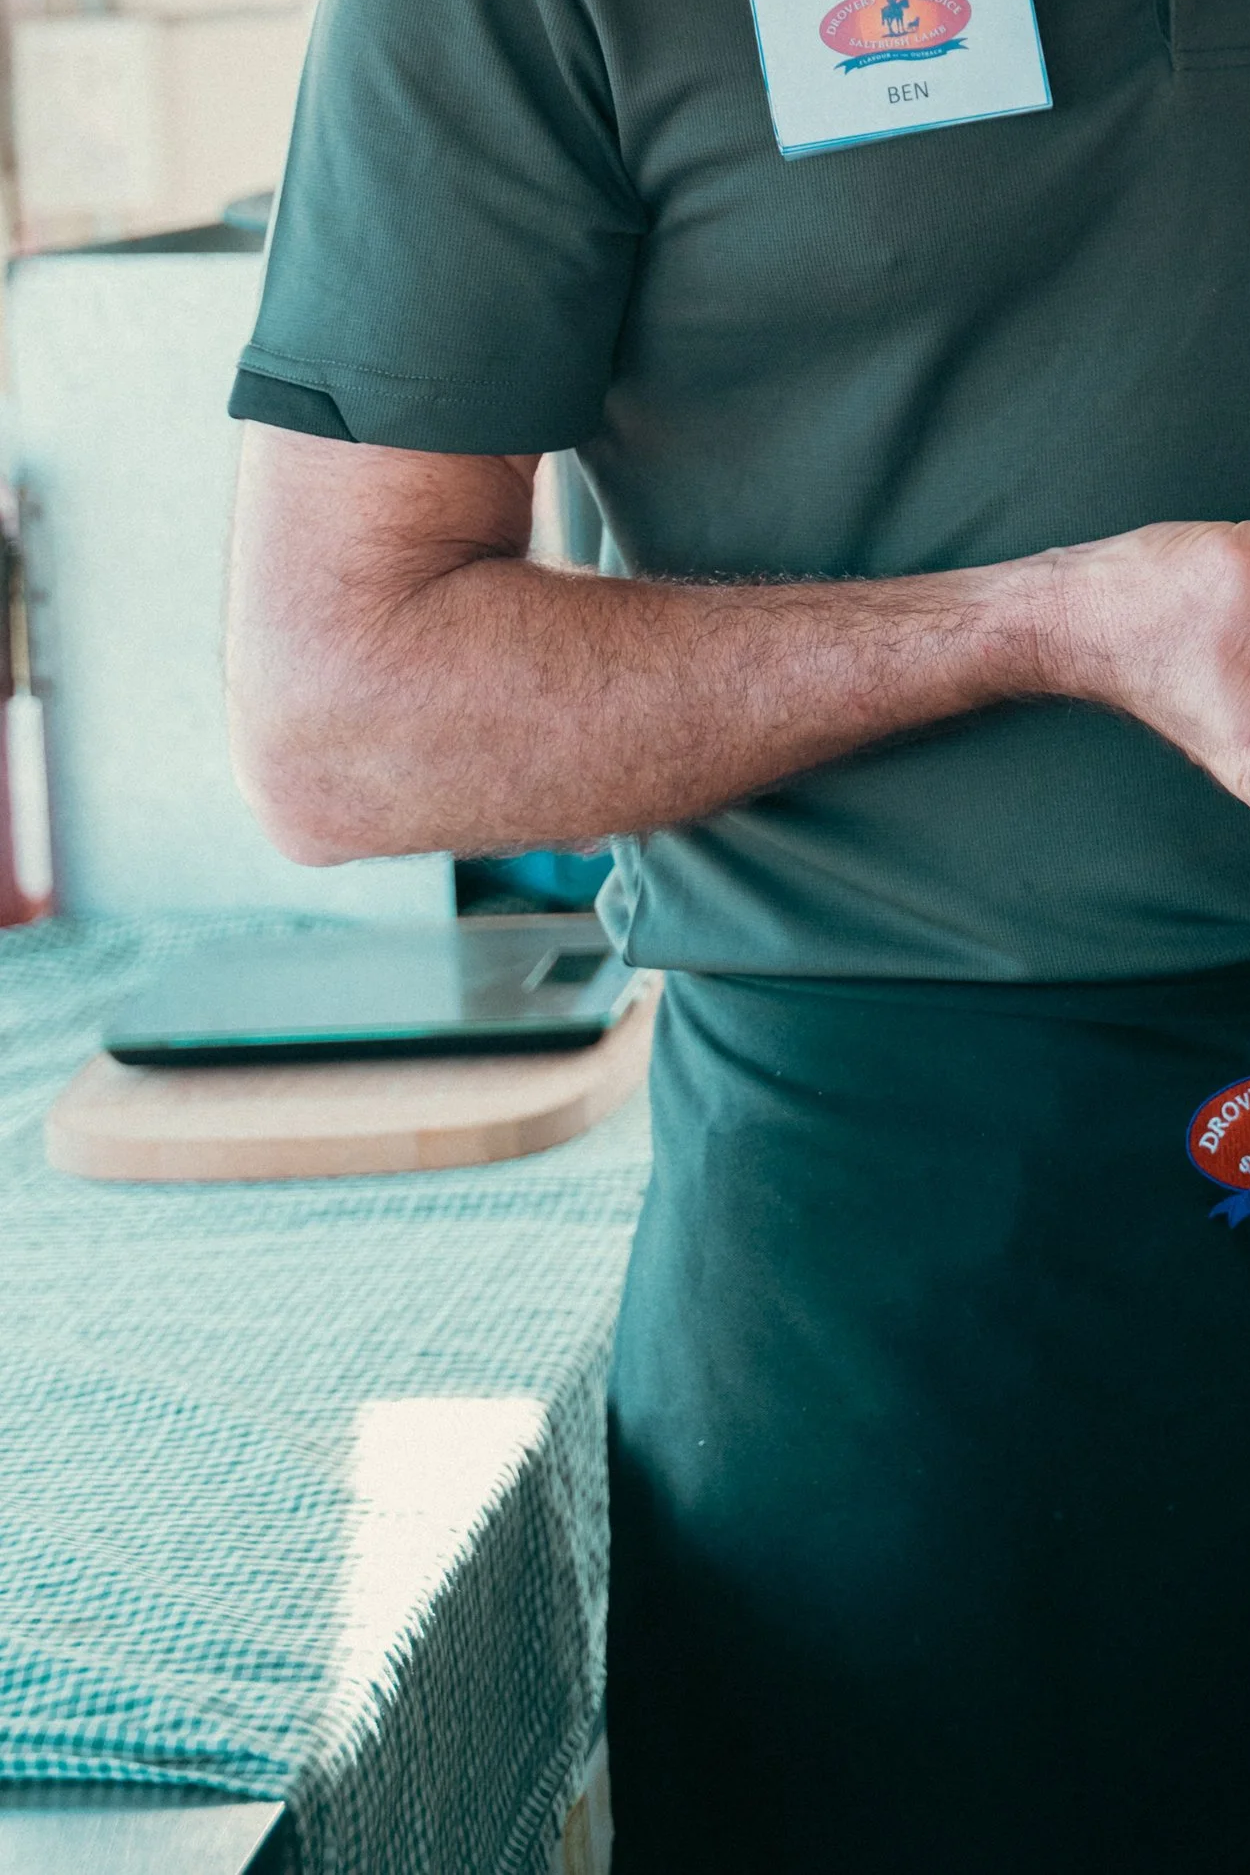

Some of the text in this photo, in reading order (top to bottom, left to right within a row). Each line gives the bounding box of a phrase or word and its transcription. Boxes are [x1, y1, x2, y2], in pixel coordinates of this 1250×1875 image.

[849, 25, 947, 50] SALTBUSH LAMB
[887, 81, 929, 104] BEN
